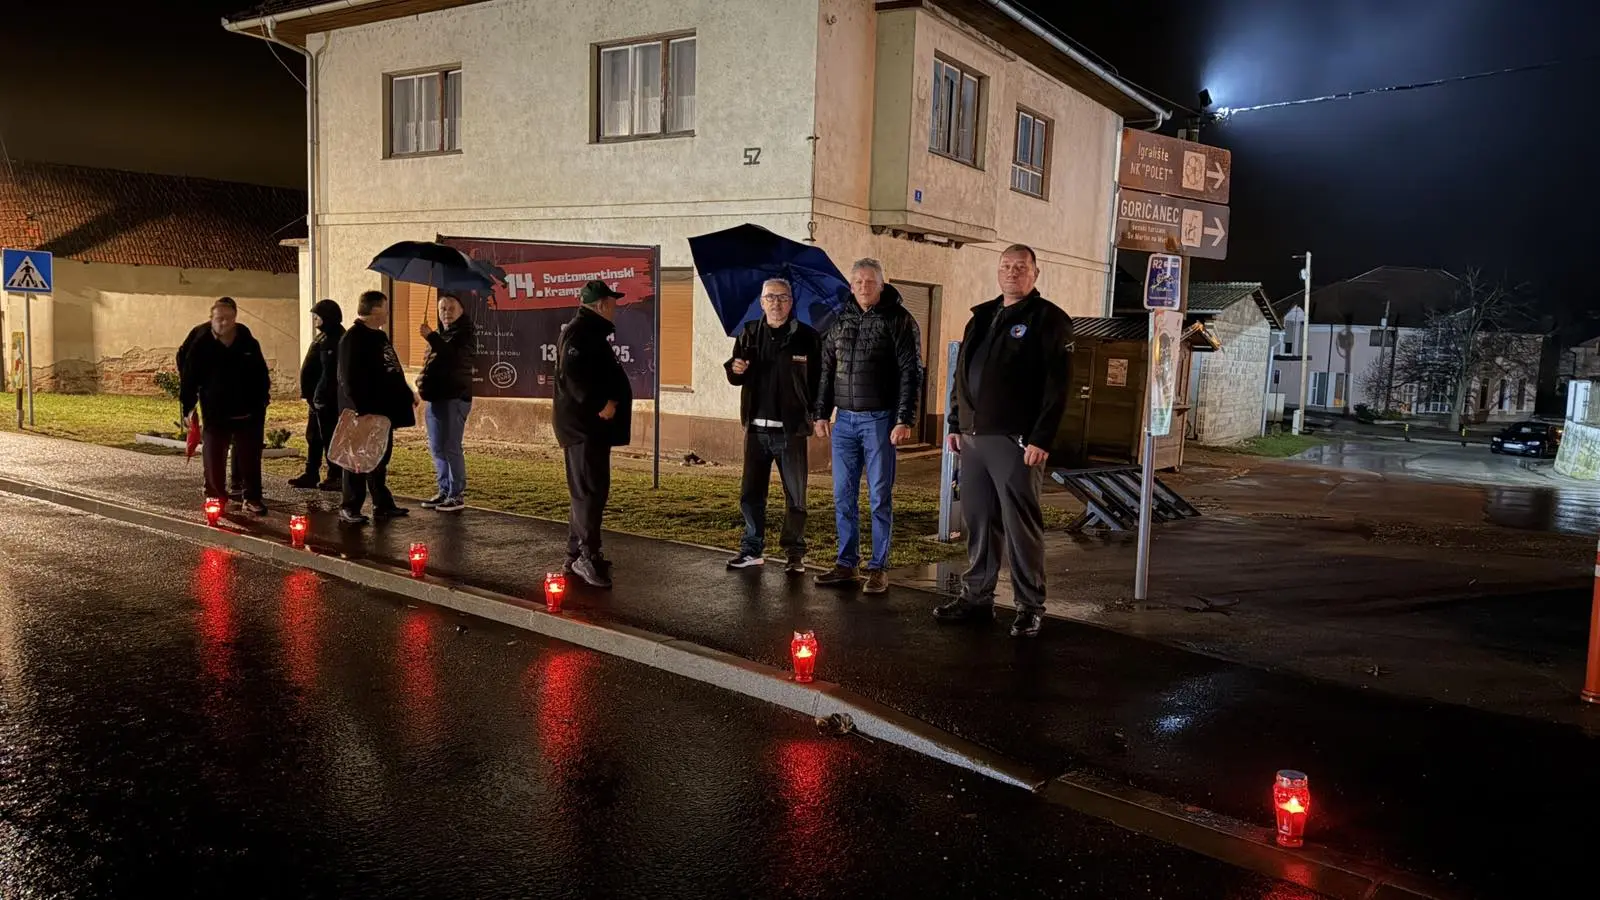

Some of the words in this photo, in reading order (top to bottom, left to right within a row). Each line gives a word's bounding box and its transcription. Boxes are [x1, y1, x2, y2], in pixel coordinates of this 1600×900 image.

[1137, 142, 1169, 162] Igralište
[1129, 161, 1141, 176] NK
[1120, 199, 1180, 224] GORIČANEC
[1152, 259, 1163, 269] R2
[504, 272, 543, 299] 14.
[543, 267, 635, 284] Svetomartinski
